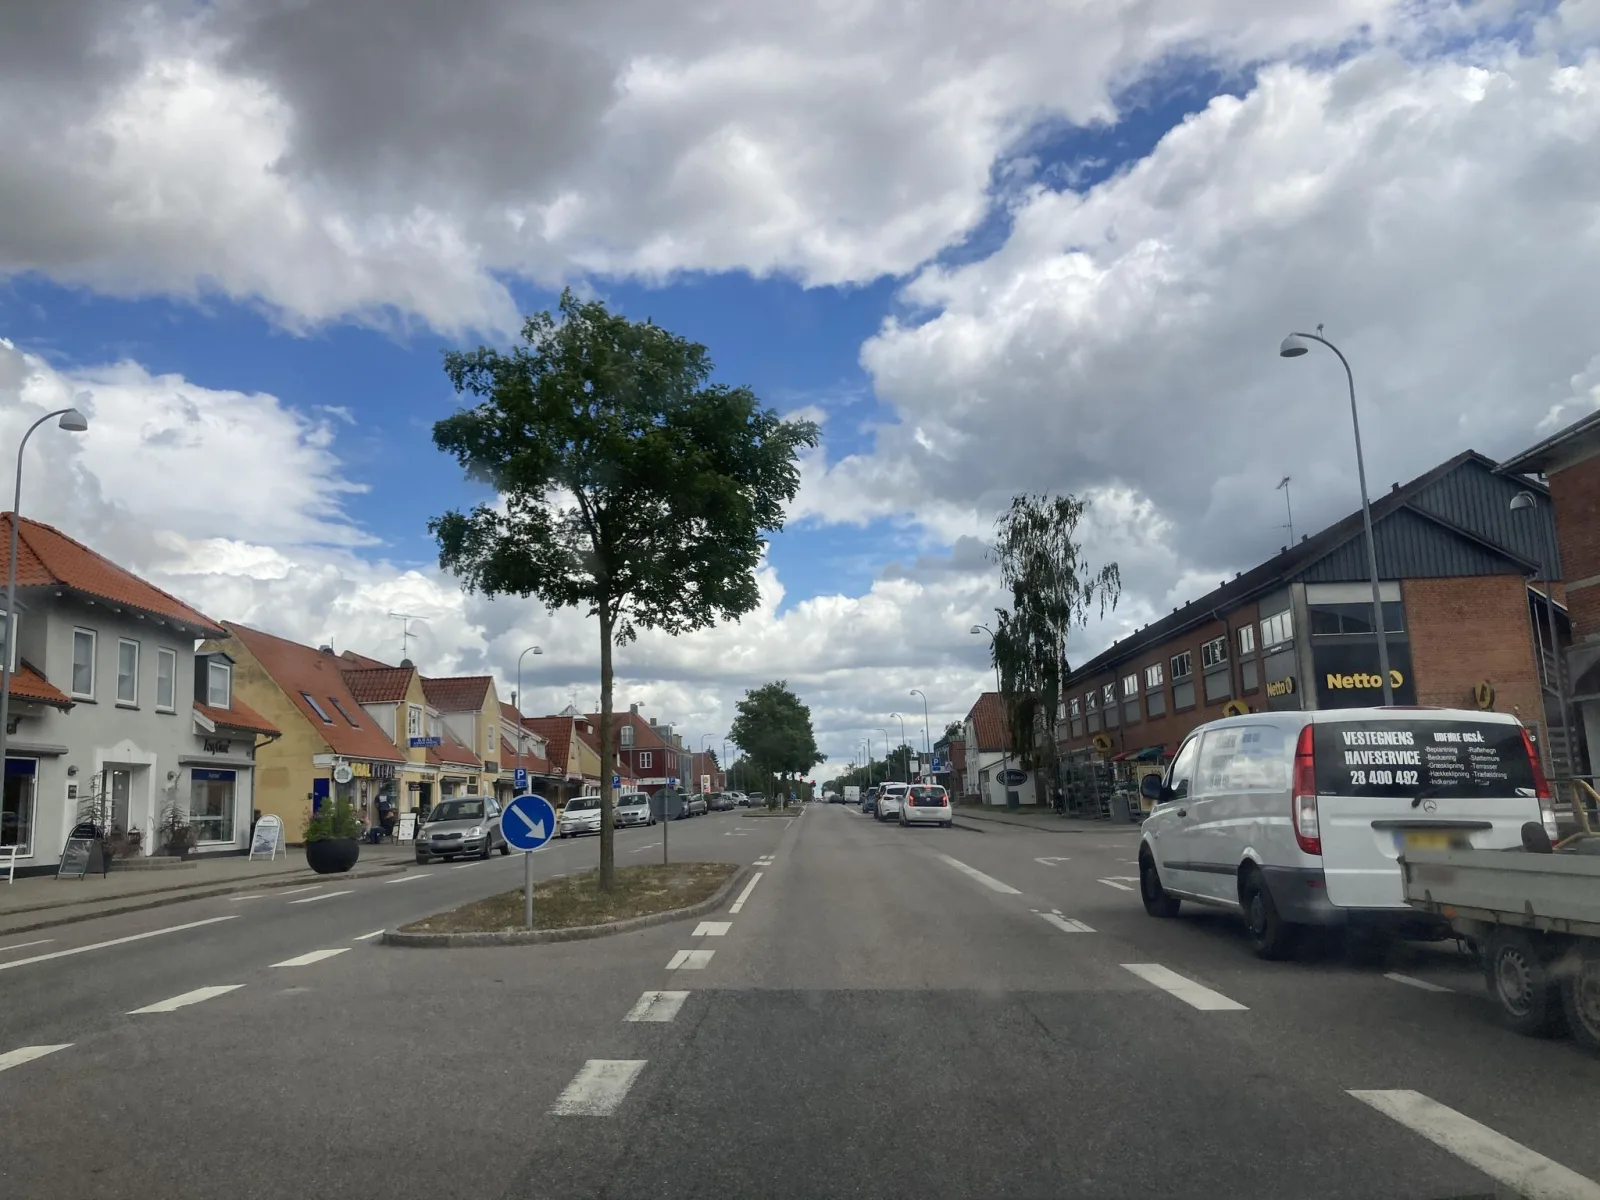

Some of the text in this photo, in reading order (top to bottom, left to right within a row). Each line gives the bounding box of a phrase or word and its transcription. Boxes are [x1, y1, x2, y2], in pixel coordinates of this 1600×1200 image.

[1266, 680, 1285, 697] Netto
[1327, 672, 1383, 690] Netto
[1342, 731, 1415, 746] VESTEGNENS
[1344, 750, 1422, 765] HAVESERVICE
[517, 769, 525, 780] P
[1350, 770, 1420, 785] 28 400 492
